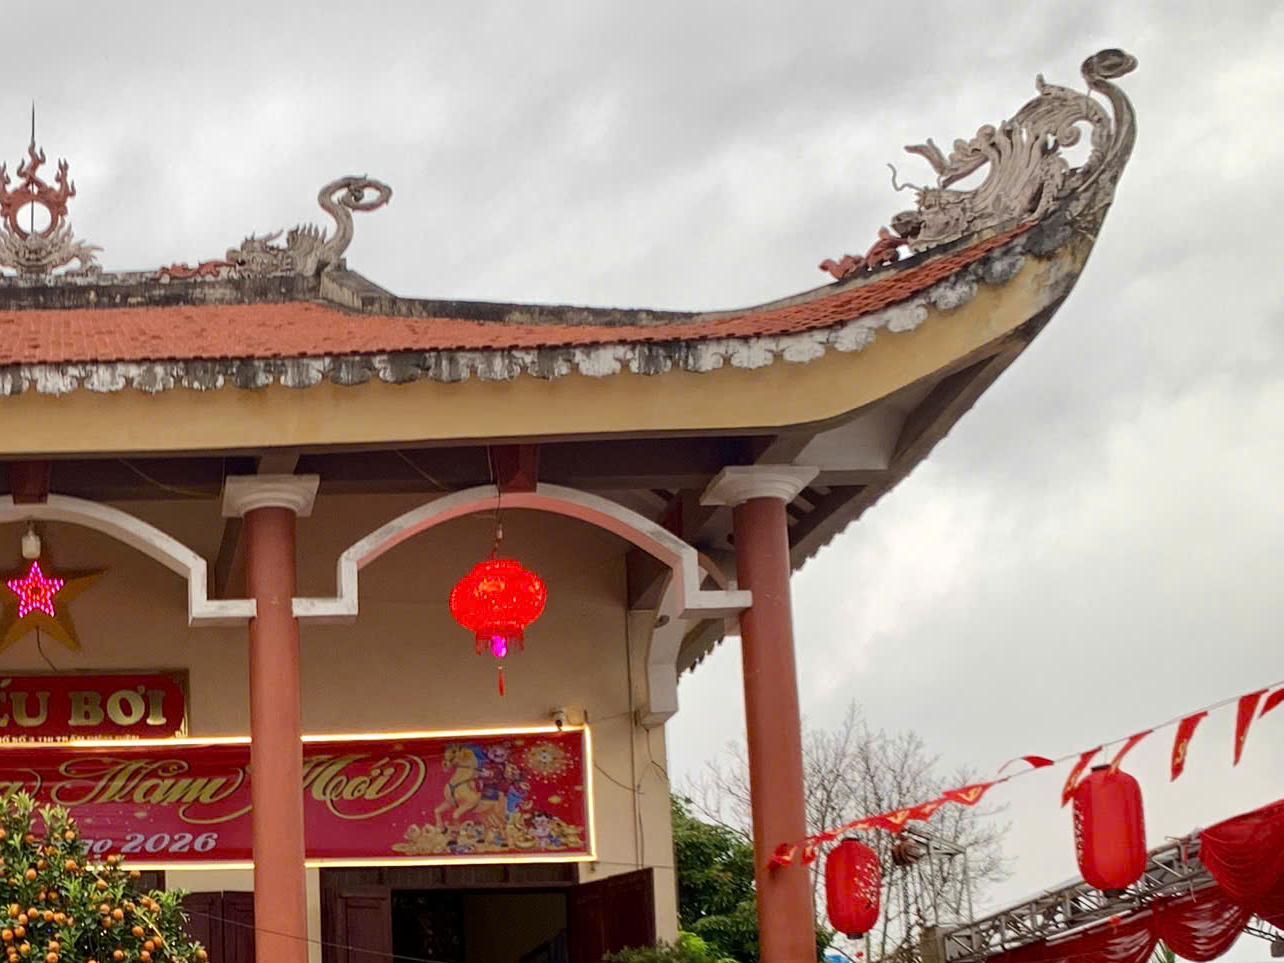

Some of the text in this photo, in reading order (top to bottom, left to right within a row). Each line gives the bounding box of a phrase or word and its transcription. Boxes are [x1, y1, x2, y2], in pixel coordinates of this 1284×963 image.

[68, 684, 167, 726] BƠI
[51, 756, 244, 806] Năm
[121, 832, 218, 853] 2026
